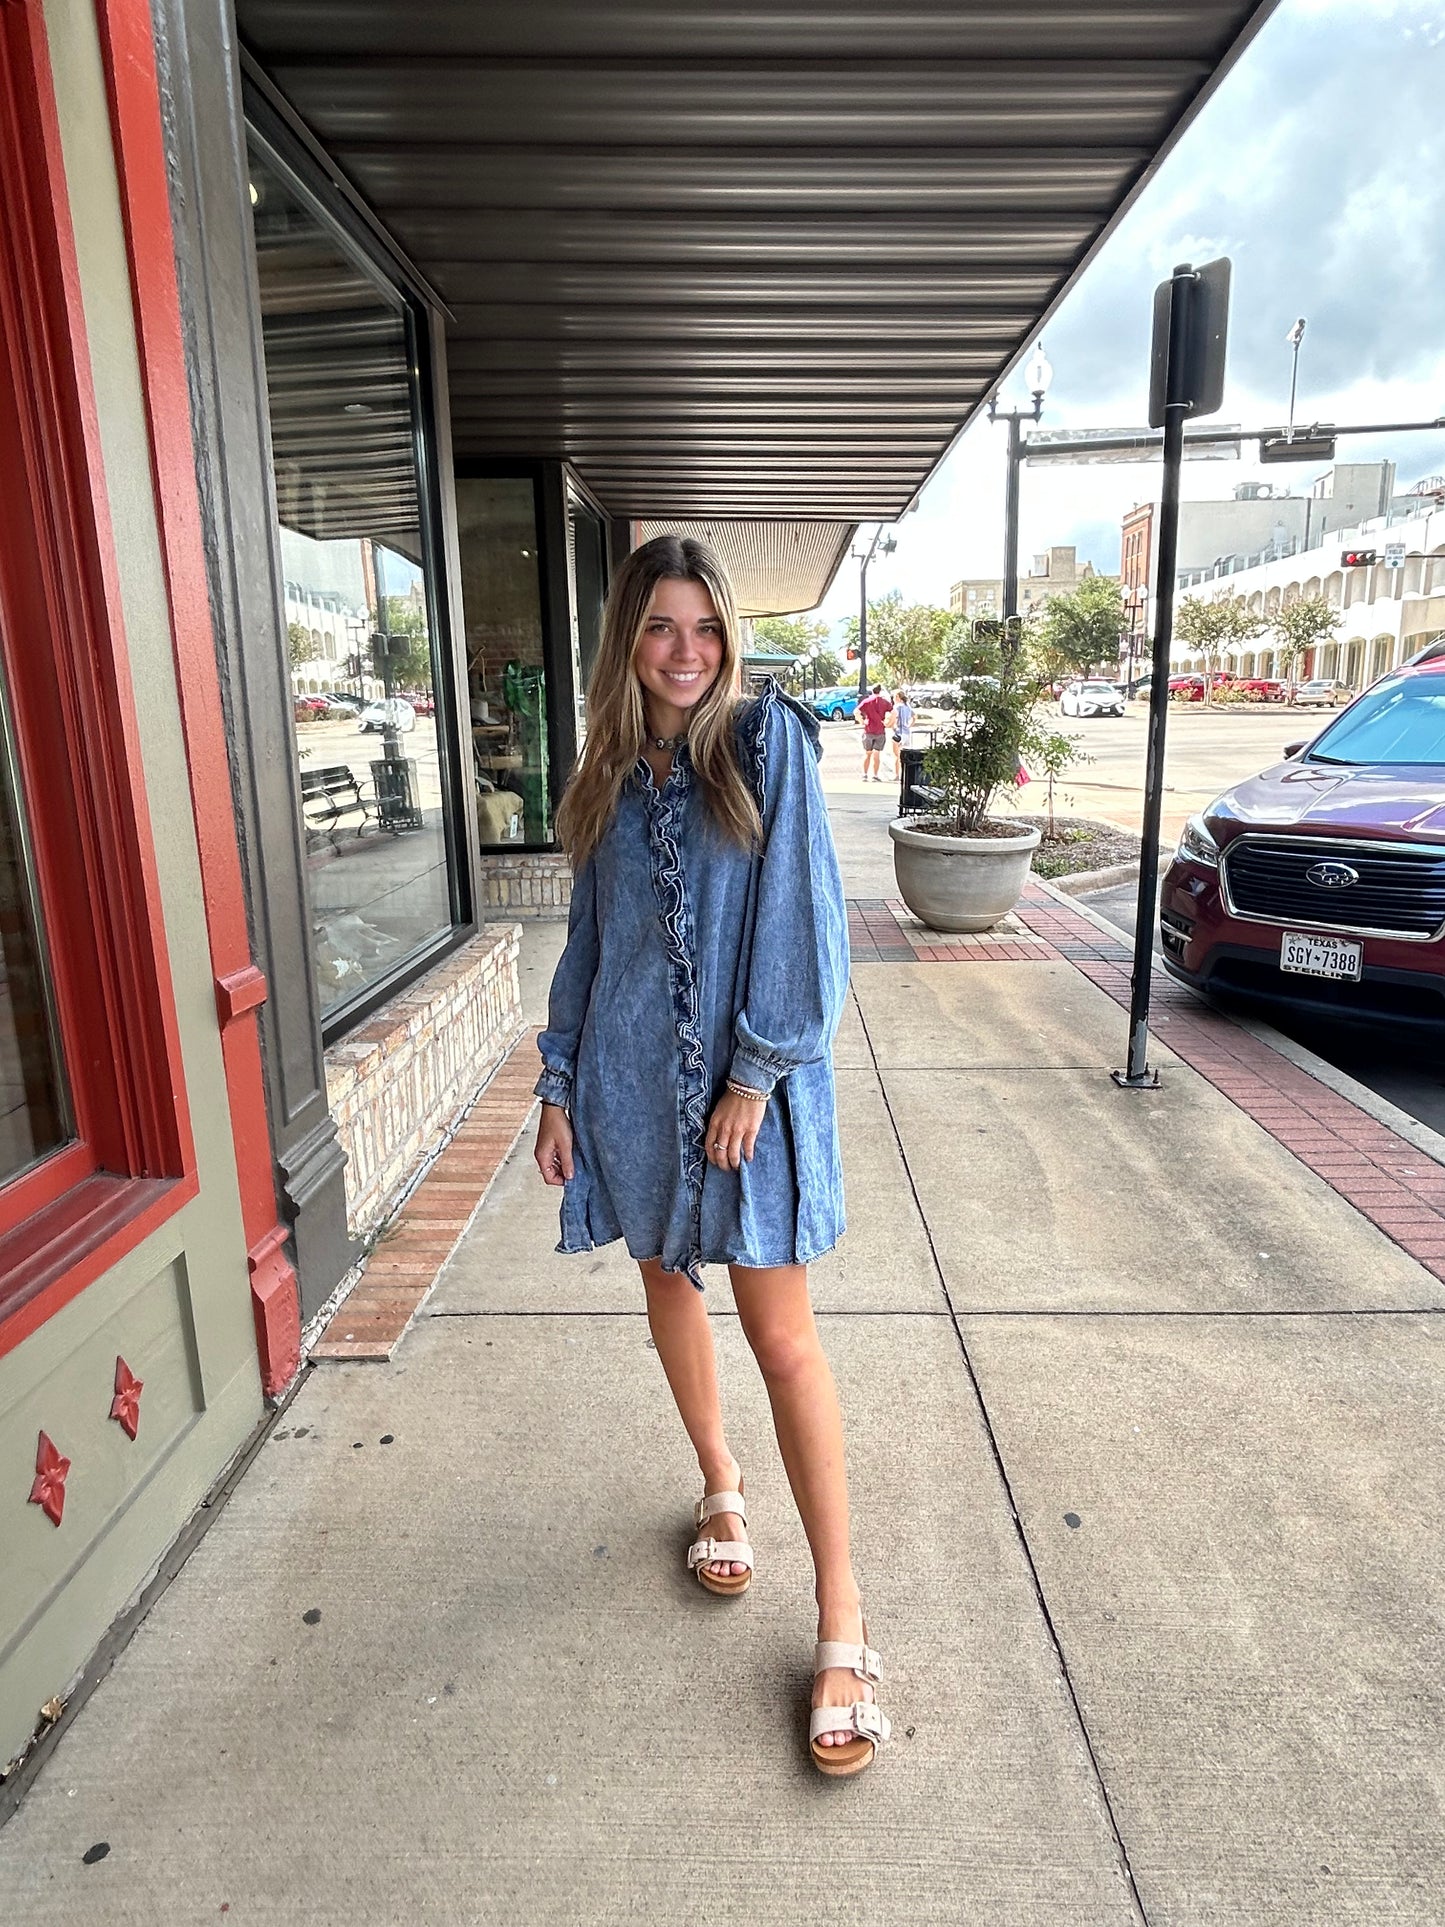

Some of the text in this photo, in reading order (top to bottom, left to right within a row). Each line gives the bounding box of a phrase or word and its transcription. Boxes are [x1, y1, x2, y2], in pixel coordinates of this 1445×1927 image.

[1308, 938, 1338, 948] TEXAS
[1288, 946, 1356, 972] SGY 7388
